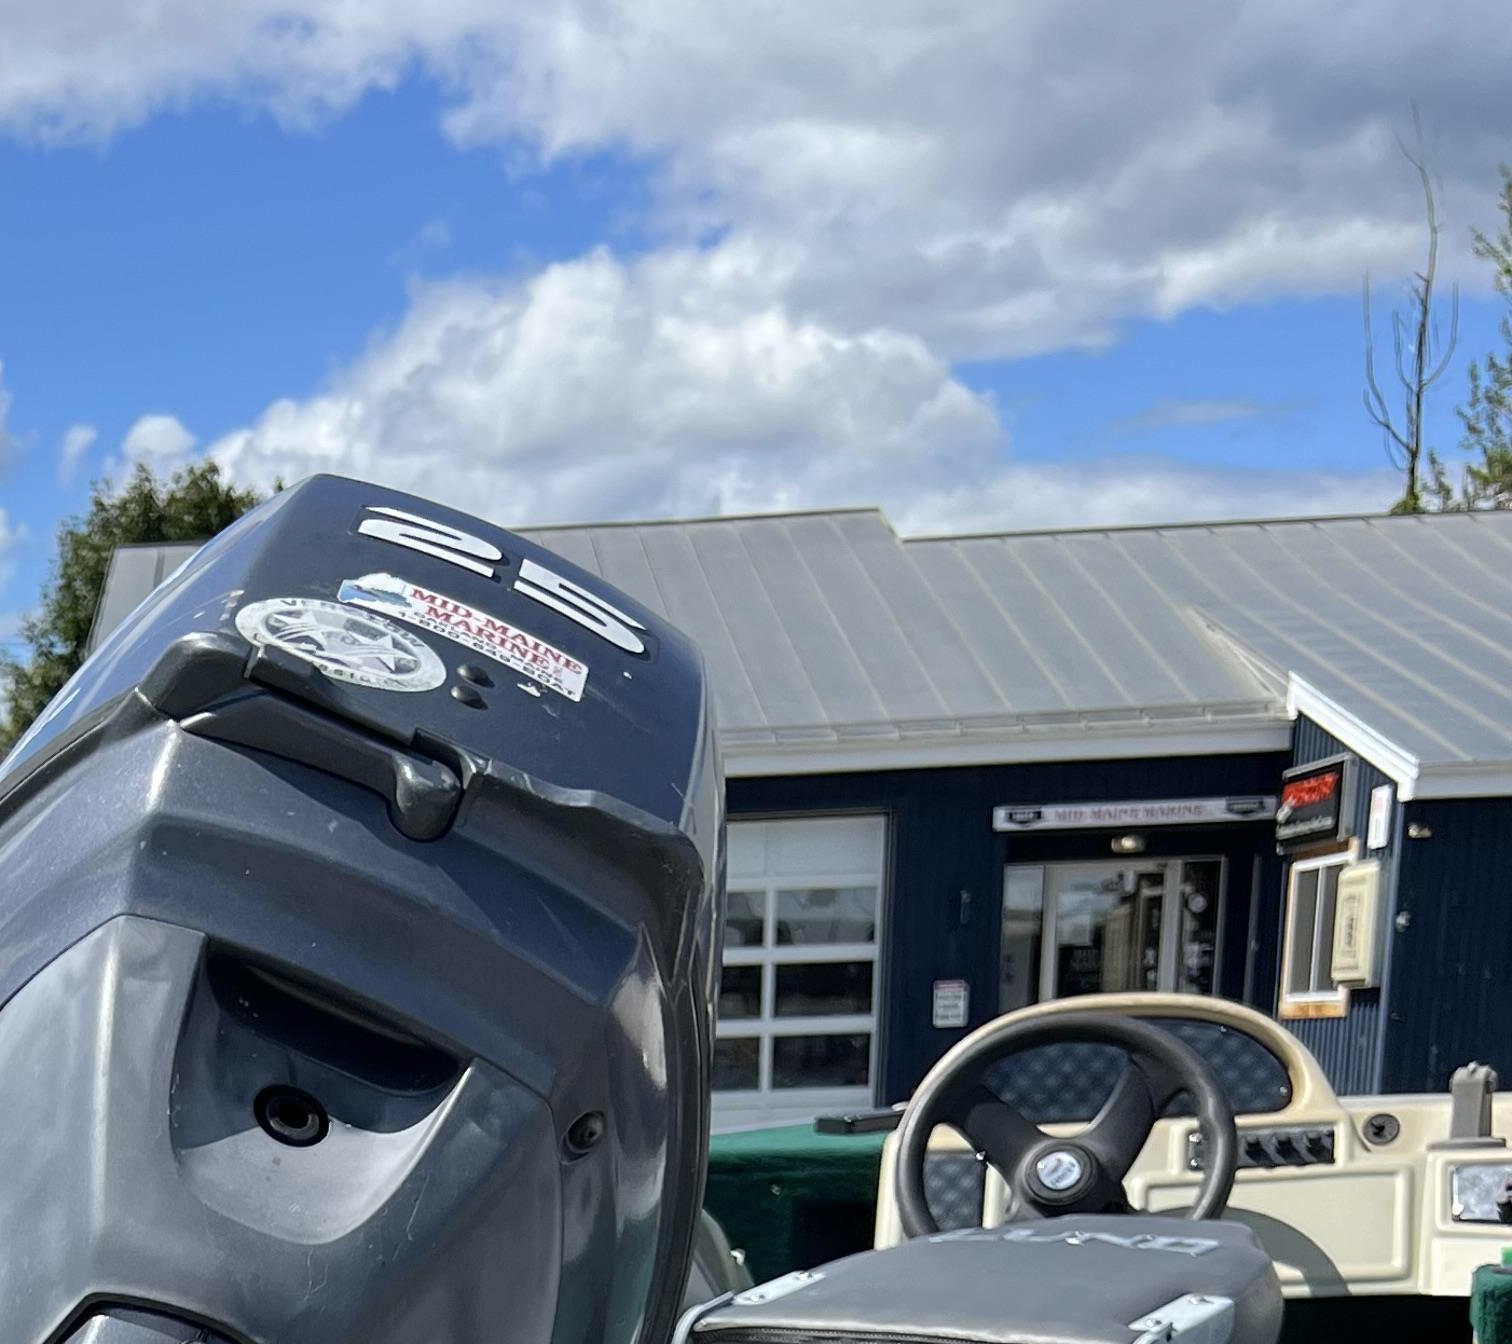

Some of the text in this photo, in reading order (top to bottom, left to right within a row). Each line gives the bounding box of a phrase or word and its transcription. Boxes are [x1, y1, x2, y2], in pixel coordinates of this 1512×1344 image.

[357, 506, 647, 654] 25
[411, 587, 583, 675] MID-MAINE
[425, 605, 551, 671] MARINE
